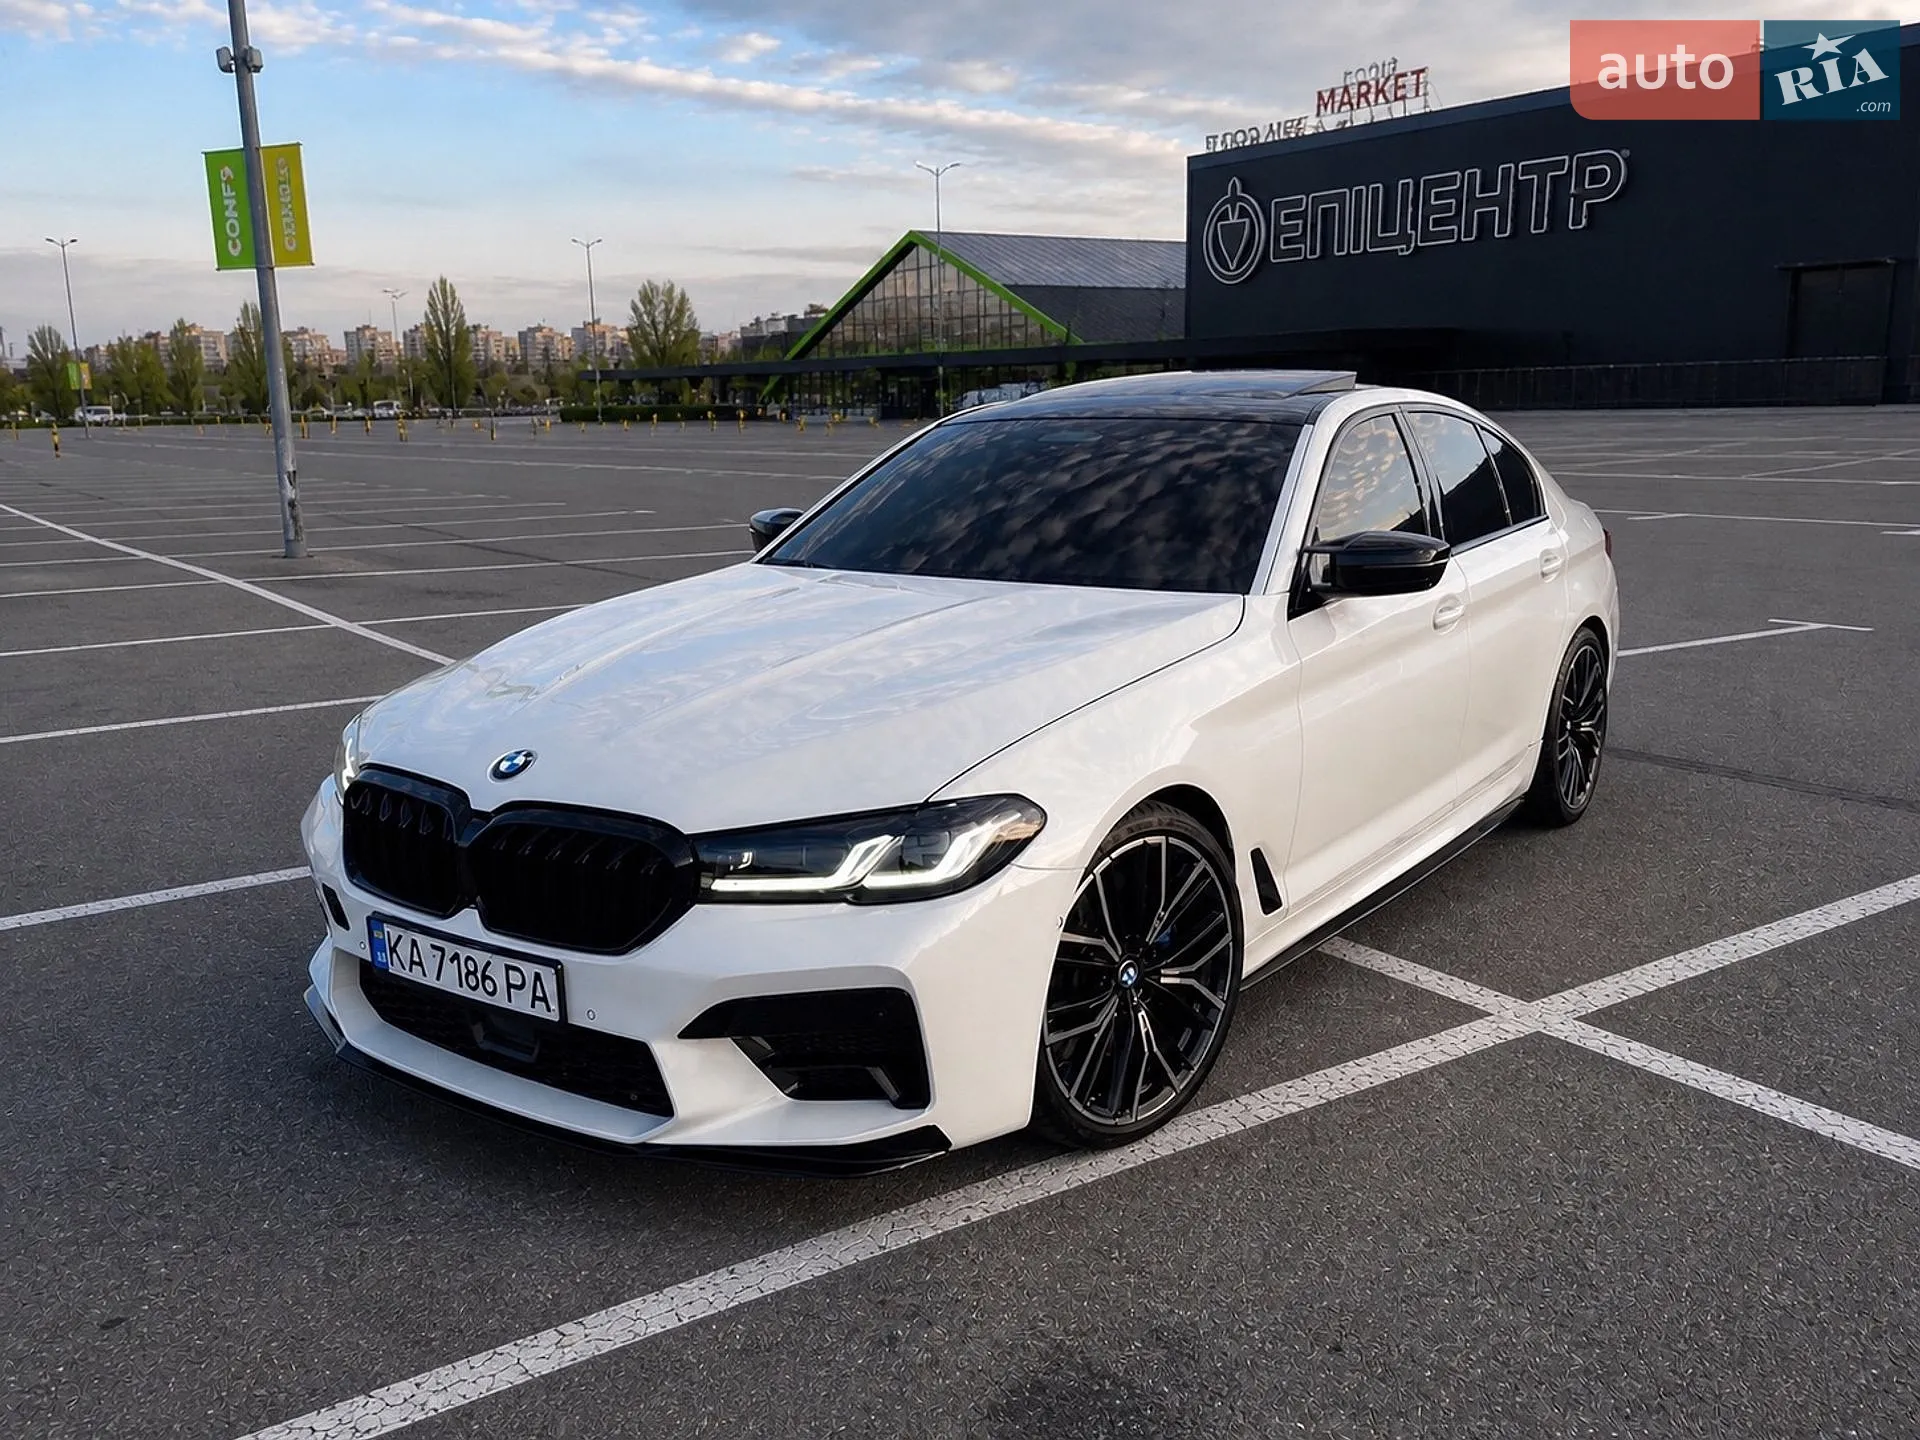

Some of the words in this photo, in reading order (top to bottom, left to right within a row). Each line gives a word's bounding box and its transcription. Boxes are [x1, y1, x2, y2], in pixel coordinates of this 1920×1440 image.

[1316, 66, 1428, 117] MARKET
[1270, 149, 1628, 263] ЕПІЦЕНТР
[386, 930, 427, 978] KA
[430, 943, 498, 997] 7186
[504, 963, 551, 1013] PA
